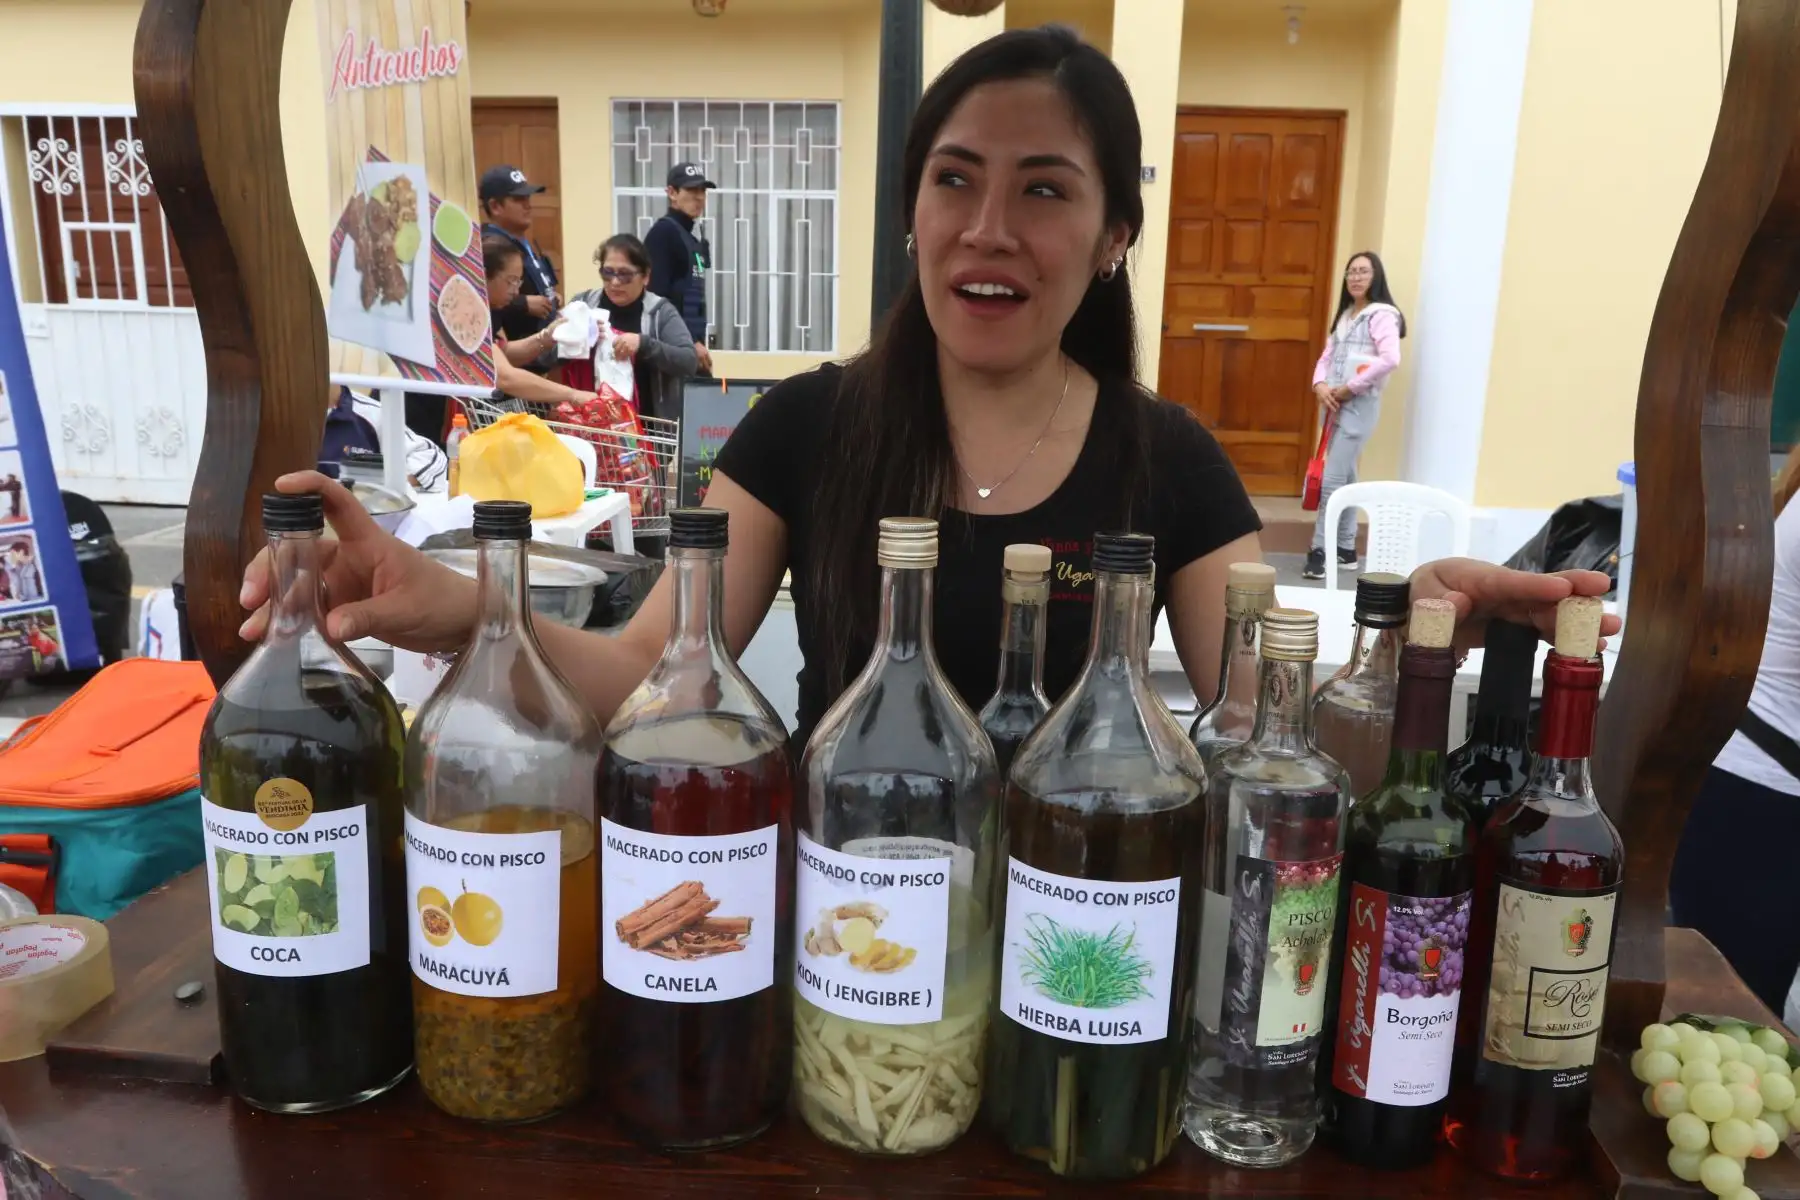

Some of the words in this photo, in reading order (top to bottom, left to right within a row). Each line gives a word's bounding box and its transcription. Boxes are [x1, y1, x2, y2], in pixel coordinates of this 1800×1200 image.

[329, 28, 463, 101] Anticuchos
[205, 819, 269, 845] MACERADO
[273, 831, 309, 845] CON
[314, 824, 360, 843] PISCO
[405, 829, 457, 863] MACERADO
[461, 852, 495, 867] CON
[500, 851, 546, 867] PISCO
[606, 835, 683, 864] MACERADO
[688, 850, 723, 864] CON
[728, 842, 768, 862] PISCO
[798, 846, 856, 883] MACERADO
[860, 871, 895, 887] CON
[900, 872, 945, 887] PISCO
[1010, 867, 1088, 904] MACERADO
[1092, 892, 1129, 906] CON
[1134, 888, 1176, 906] PISCO
[1288, 907, 1332, 926] PISCO
[1393, 906, 1412, 914] 12.0%
[250, 946, 301, 962] COCA
[419, 953, 510, 986] MARACUYÁ
[644, 974, 718, 992] CANELA
[797, 961, 821, 991] KION
[834, 983, 921, 1007] JENGIBRE
[1018, 1002, 1082, 1035] HIERBA
[1088, 1020, 1142, 1037] LUISA
[1387, 1007, 1453, 1030] Borgoña
[1545, 1021, 1570, 1032] SEMI
[1571, 1019, 1593, 1031] SECO
[1398, 1030, 1423, 1040] Semi
[1424, 1030, 1443, 1040] Seco
